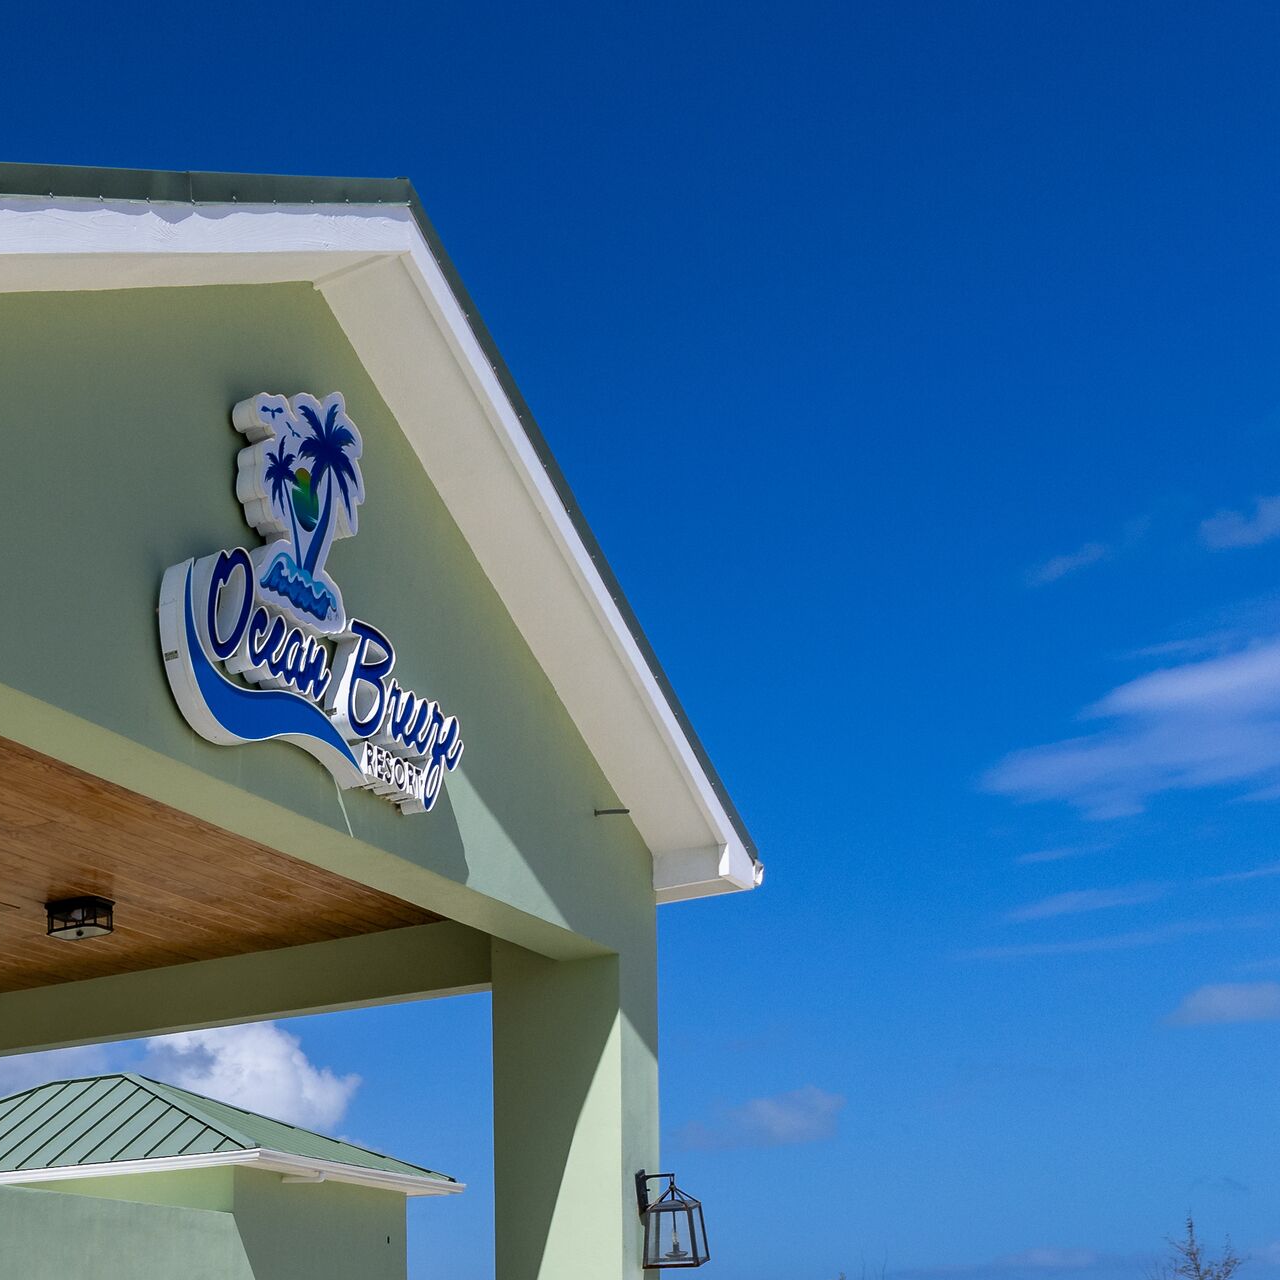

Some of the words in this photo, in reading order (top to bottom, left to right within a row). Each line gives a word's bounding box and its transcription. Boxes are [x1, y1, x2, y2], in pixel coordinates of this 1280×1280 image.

[207, 547, 332, 701] Ocean
[348, 618, 464, 812] Breeze
[365, 741, 423, 799] RESORT
